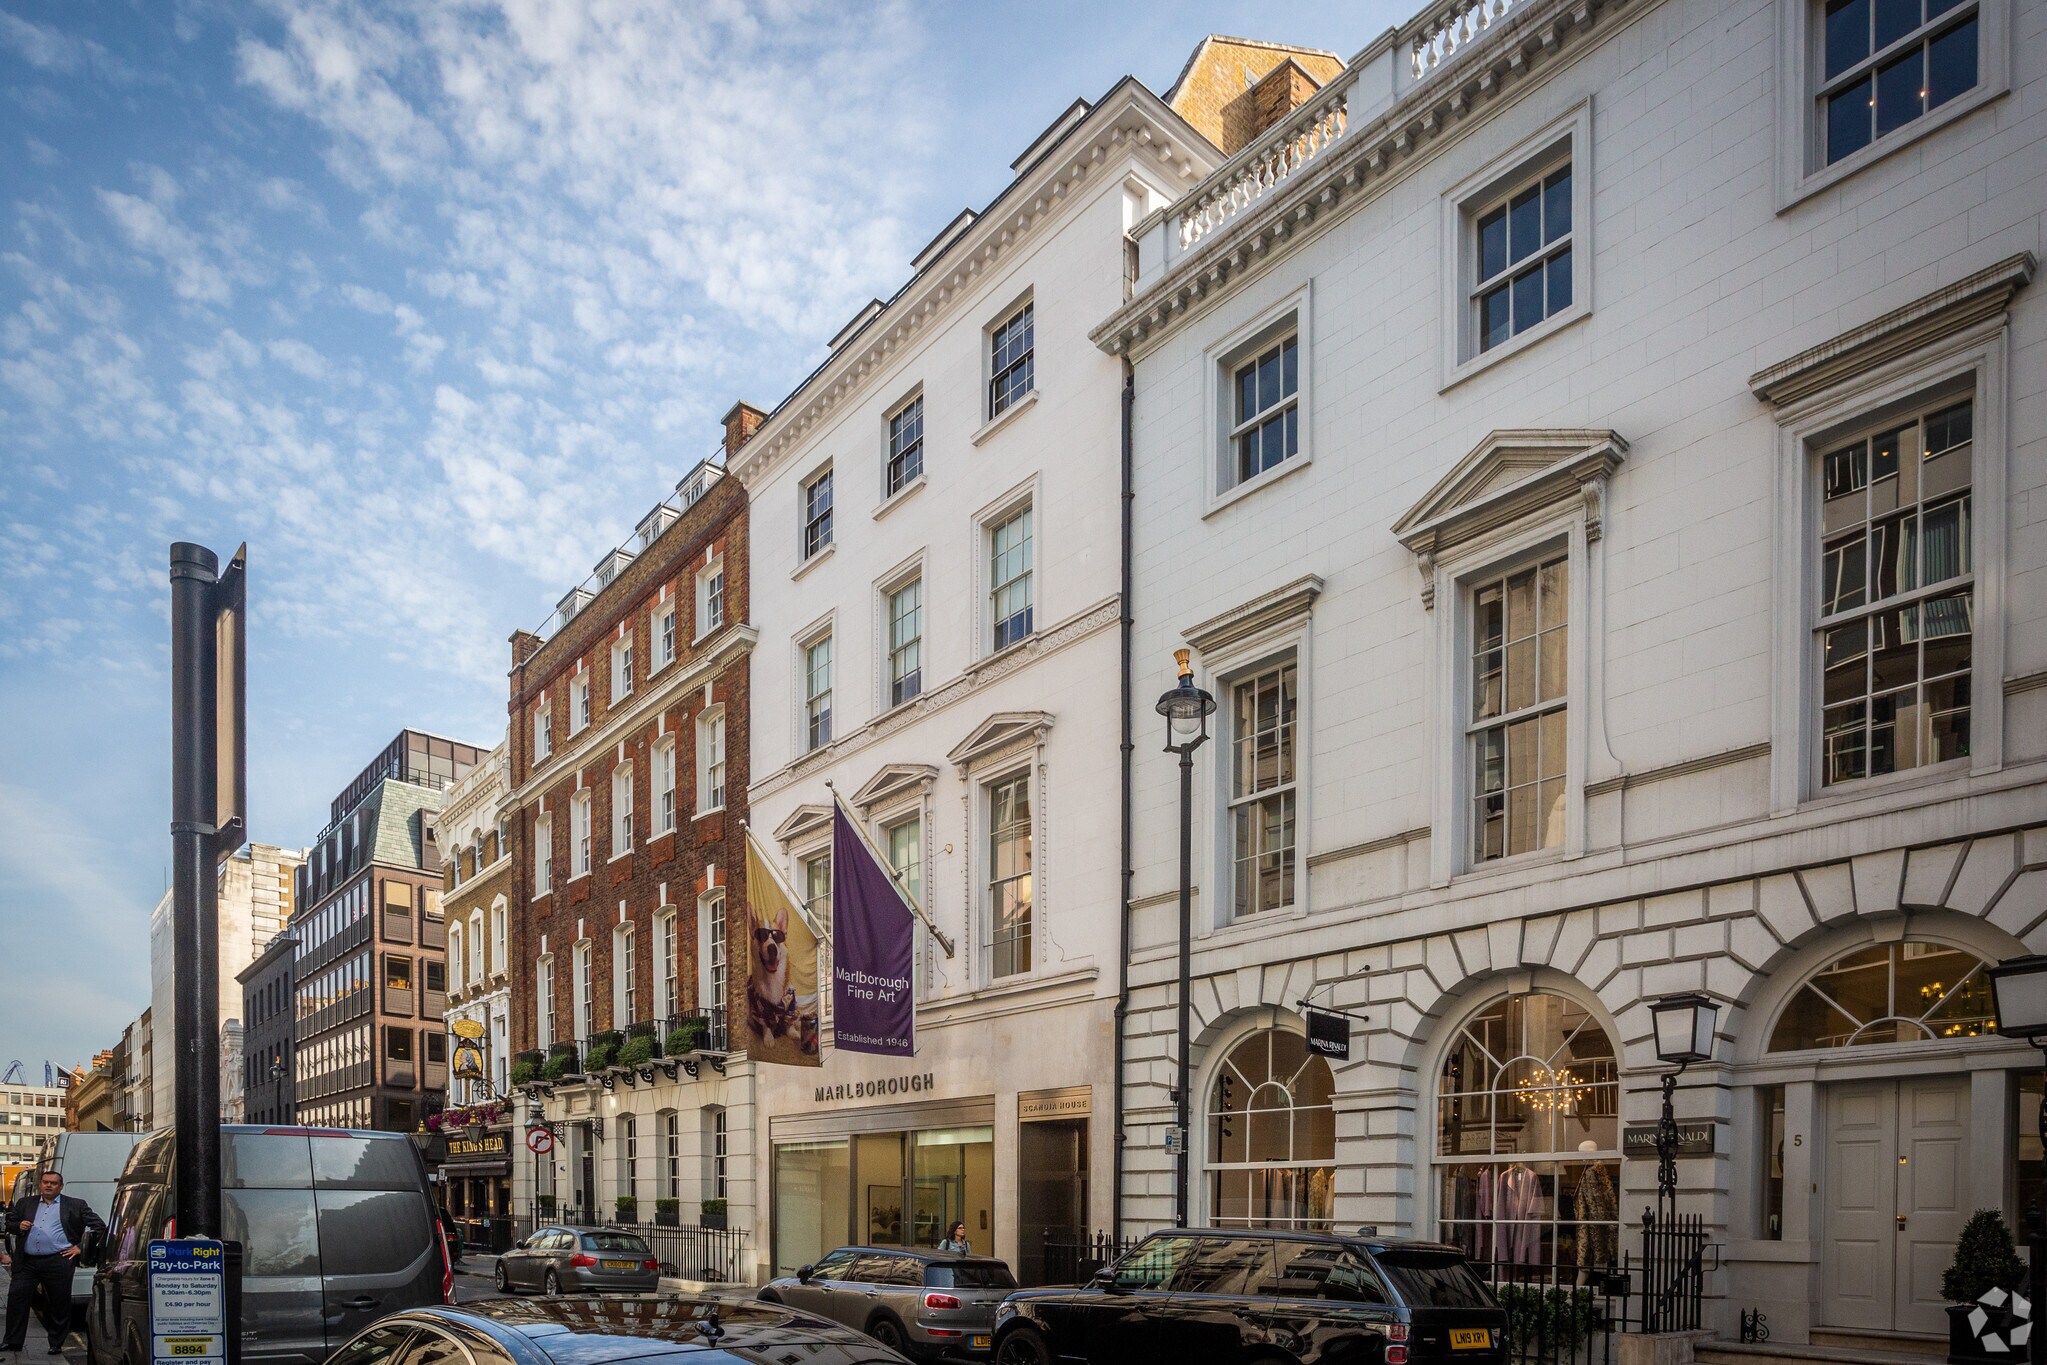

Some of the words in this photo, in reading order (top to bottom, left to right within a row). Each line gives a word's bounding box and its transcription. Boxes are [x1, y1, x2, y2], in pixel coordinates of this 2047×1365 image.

[836, 966, 909, 991] Marlborough
[847, 984, 874, 1000] Fine
[877, 989, 896, 1003] Art
[837, 1030, 883, 1045] Established
[885, 1037, 909, 1047] 1946
[815, 1073, 934, 1101] MARLBOROUGH
[1023, 1103, 1057, 1112] SCANDIA
[1059, 1100, 1087, 1109] HOUSE
[449, 1141, 461, 1153] THE
[461, 1140, 483, 1153] KINGS
[484, 1137, 503, 1151] HEAD
[1627, 1133, 1665, 1144] MARIN
[1794, 1134, 1802, 1147] 5
[168, 1247, 220, 1258] ParkRight
[151, 1260, 221, 1271] Pay-to-Park
[1455, 1332, 1472, 1344] LN19
[1473, 1331, 1485, 1343] XRY
[174, 1345, 203, 1354] 8894
